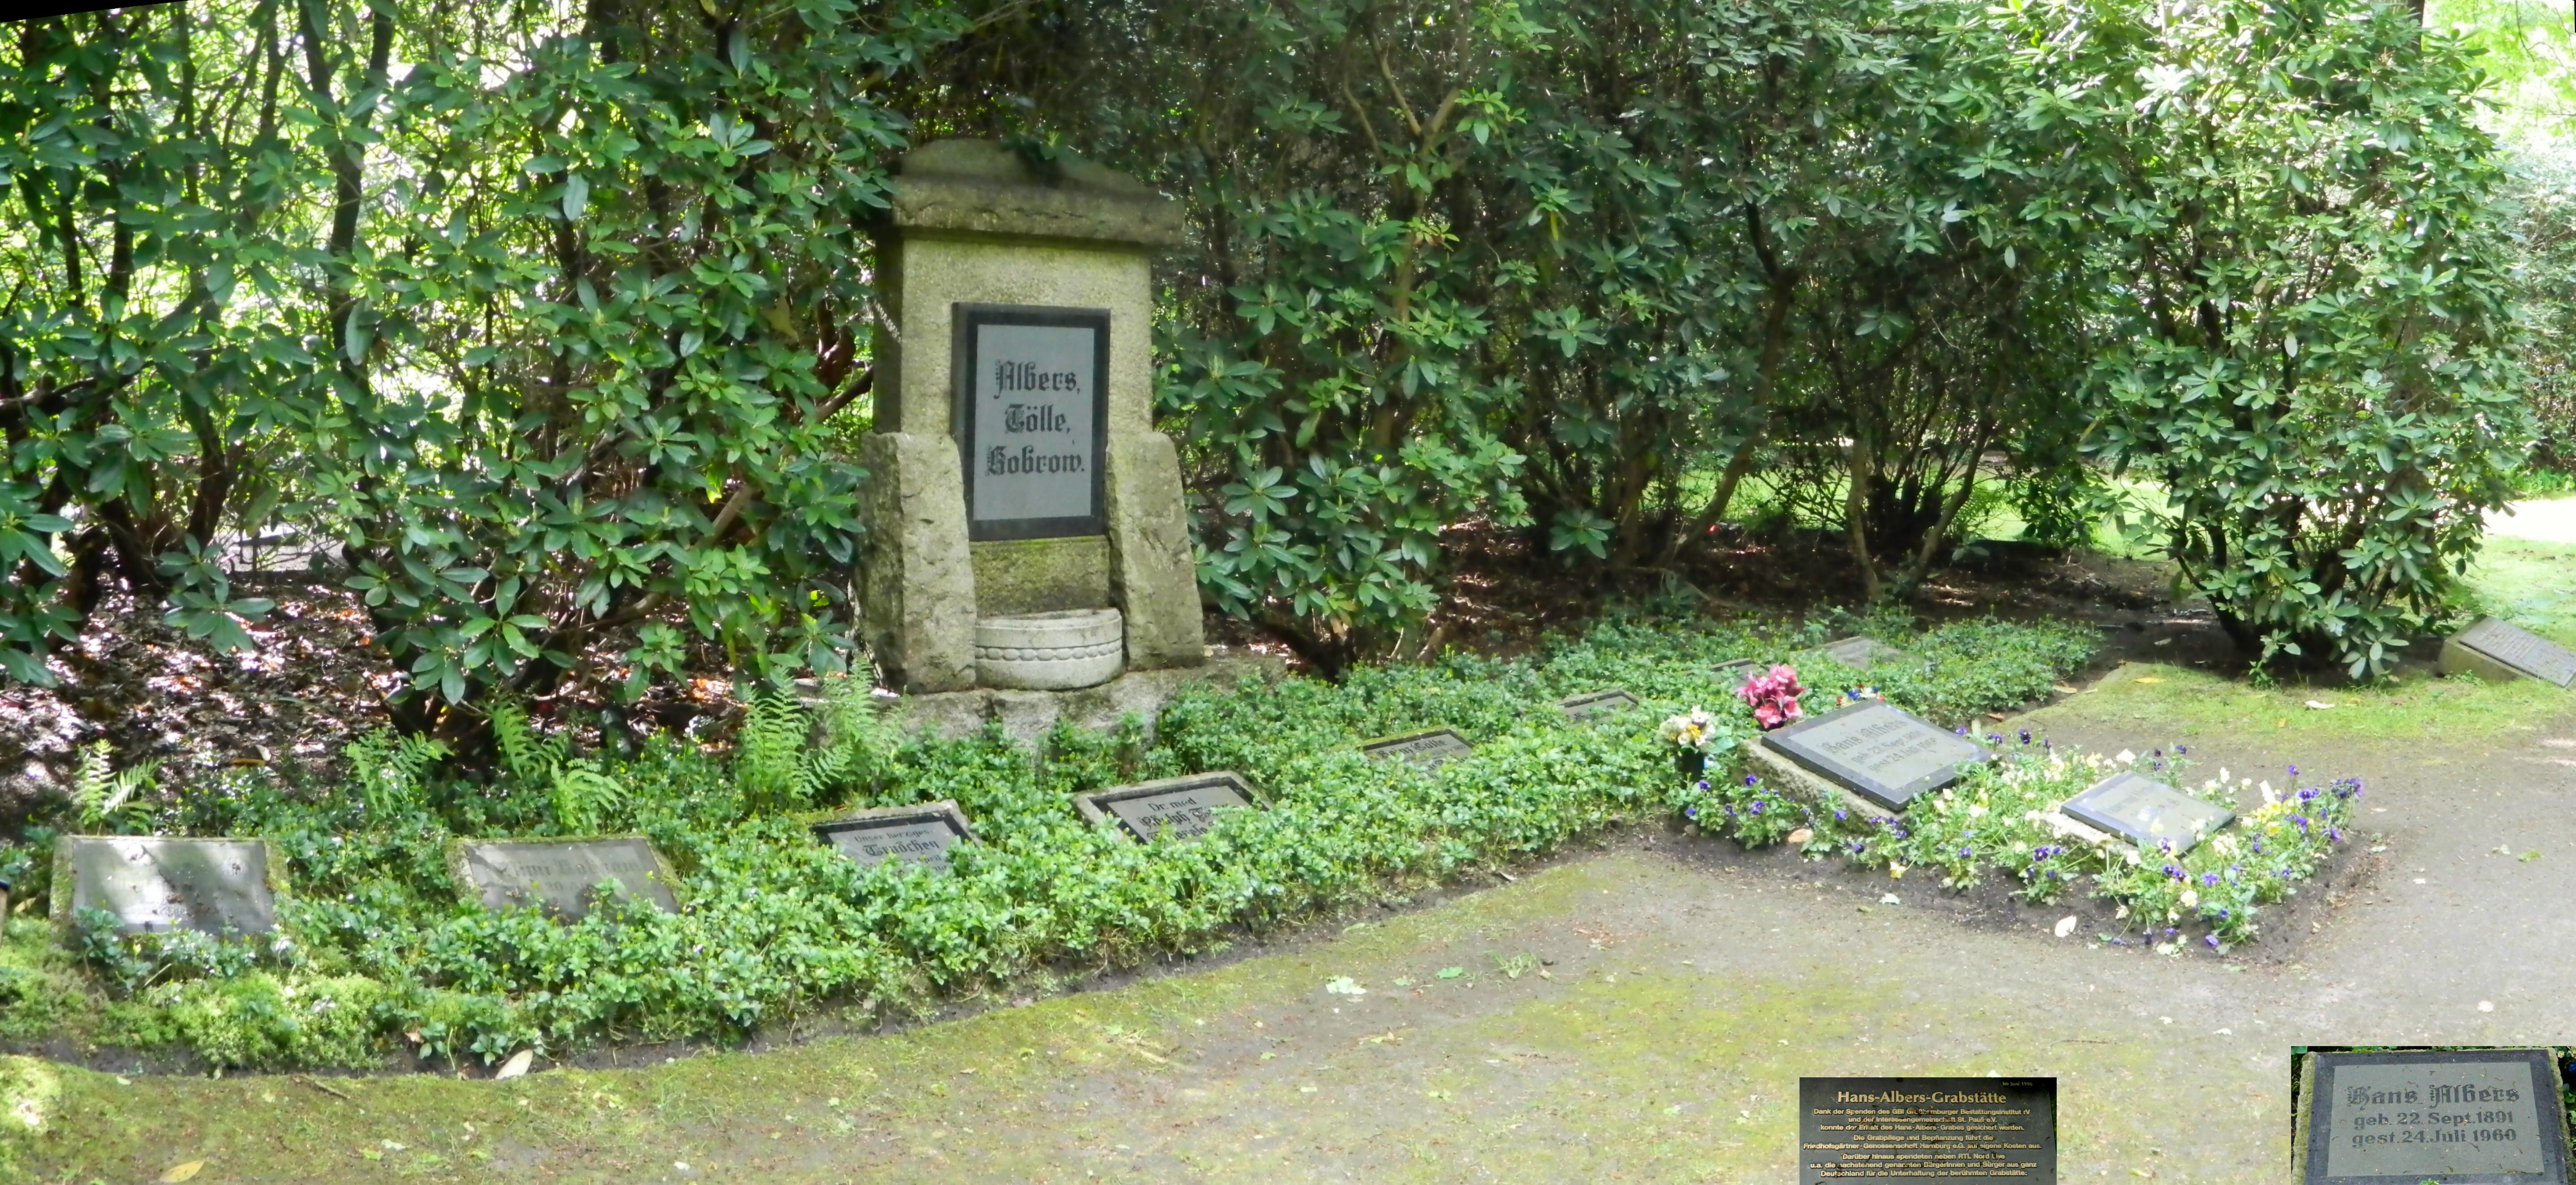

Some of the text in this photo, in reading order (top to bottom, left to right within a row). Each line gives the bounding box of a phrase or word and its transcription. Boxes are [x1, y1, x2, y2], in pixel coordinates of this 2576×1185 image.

[994, 359, 1080, 399] Albers,
[1005, 403, 1070, 434] Tölle,
[1837, 1091, 2007, 1104] Hans-Albers-Grabstätte
[2347, 1084, 2520, 1111] Hans Albers
[2472, 1128, 2517, 1142] 1960
